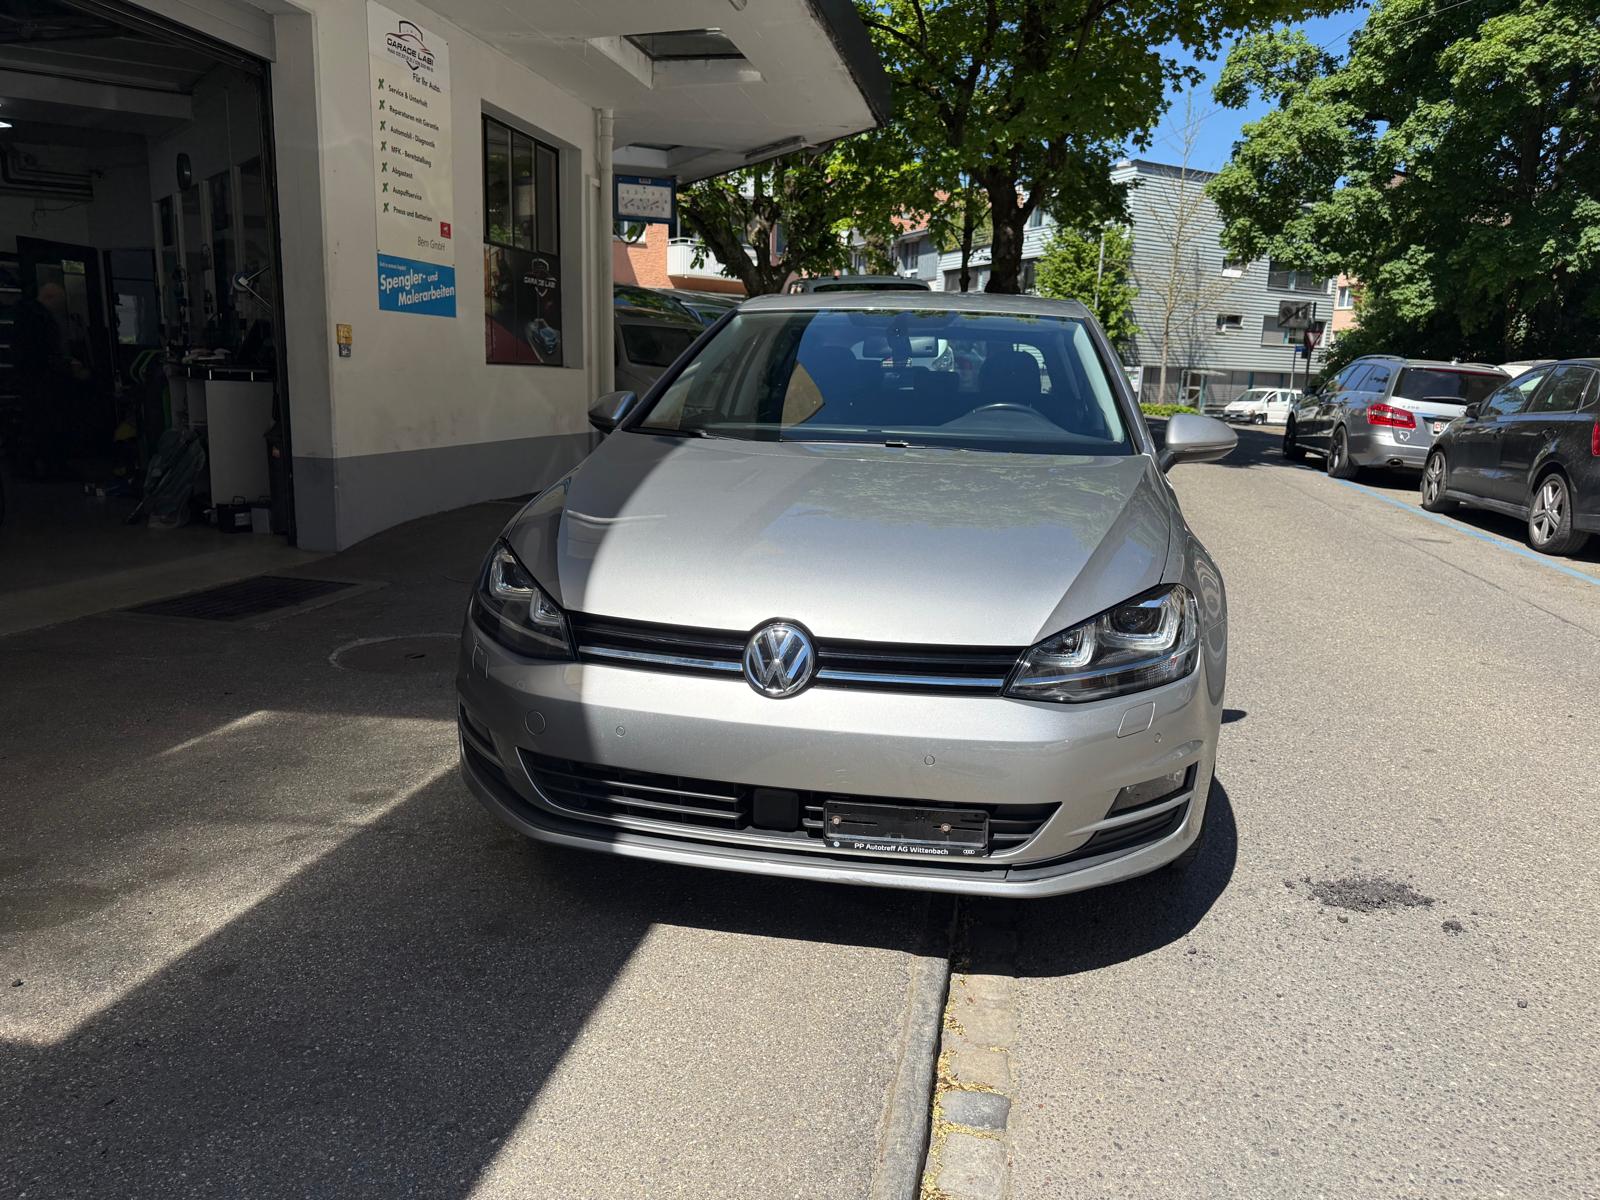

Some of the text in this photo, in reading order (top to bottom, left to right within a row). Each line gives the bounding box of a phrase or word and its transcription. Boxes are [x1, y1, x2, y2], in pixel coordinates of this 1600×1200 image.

[386, 37, 417, 58] GARAGE
[417, 53, 434, 66] LABI
[412, 72, 421, 83] Für
[388, 84, 404, 97] Service
[409, 92, 428, 108] Unterhalt
[389, 105, 415, 121] Reparaturen
[423, 119, 439, 131] Garantie
[390, 126, 412, 140] Automobil
[415, 134, 436, 148] Diagnostik
[390, 145, 402, 155] MFK
[404, 150, 432, 168] Bereitstellung
[391, 166, 413, 179] Abgastest
[392, 186, 422, 200] Auspuffservice
[393, 206, 433, 222] Pneus und Batterien
[430, 239, 446, 252] GmbH
[380, 268, 439, 294] Spengler- und
[398, 284, 455, 307] Malerarbeiten
[854, 842, 865, 850] PP
[866, 843, 896, 852] Autotreff
[909, 846, 949, 856] Wittenbach
